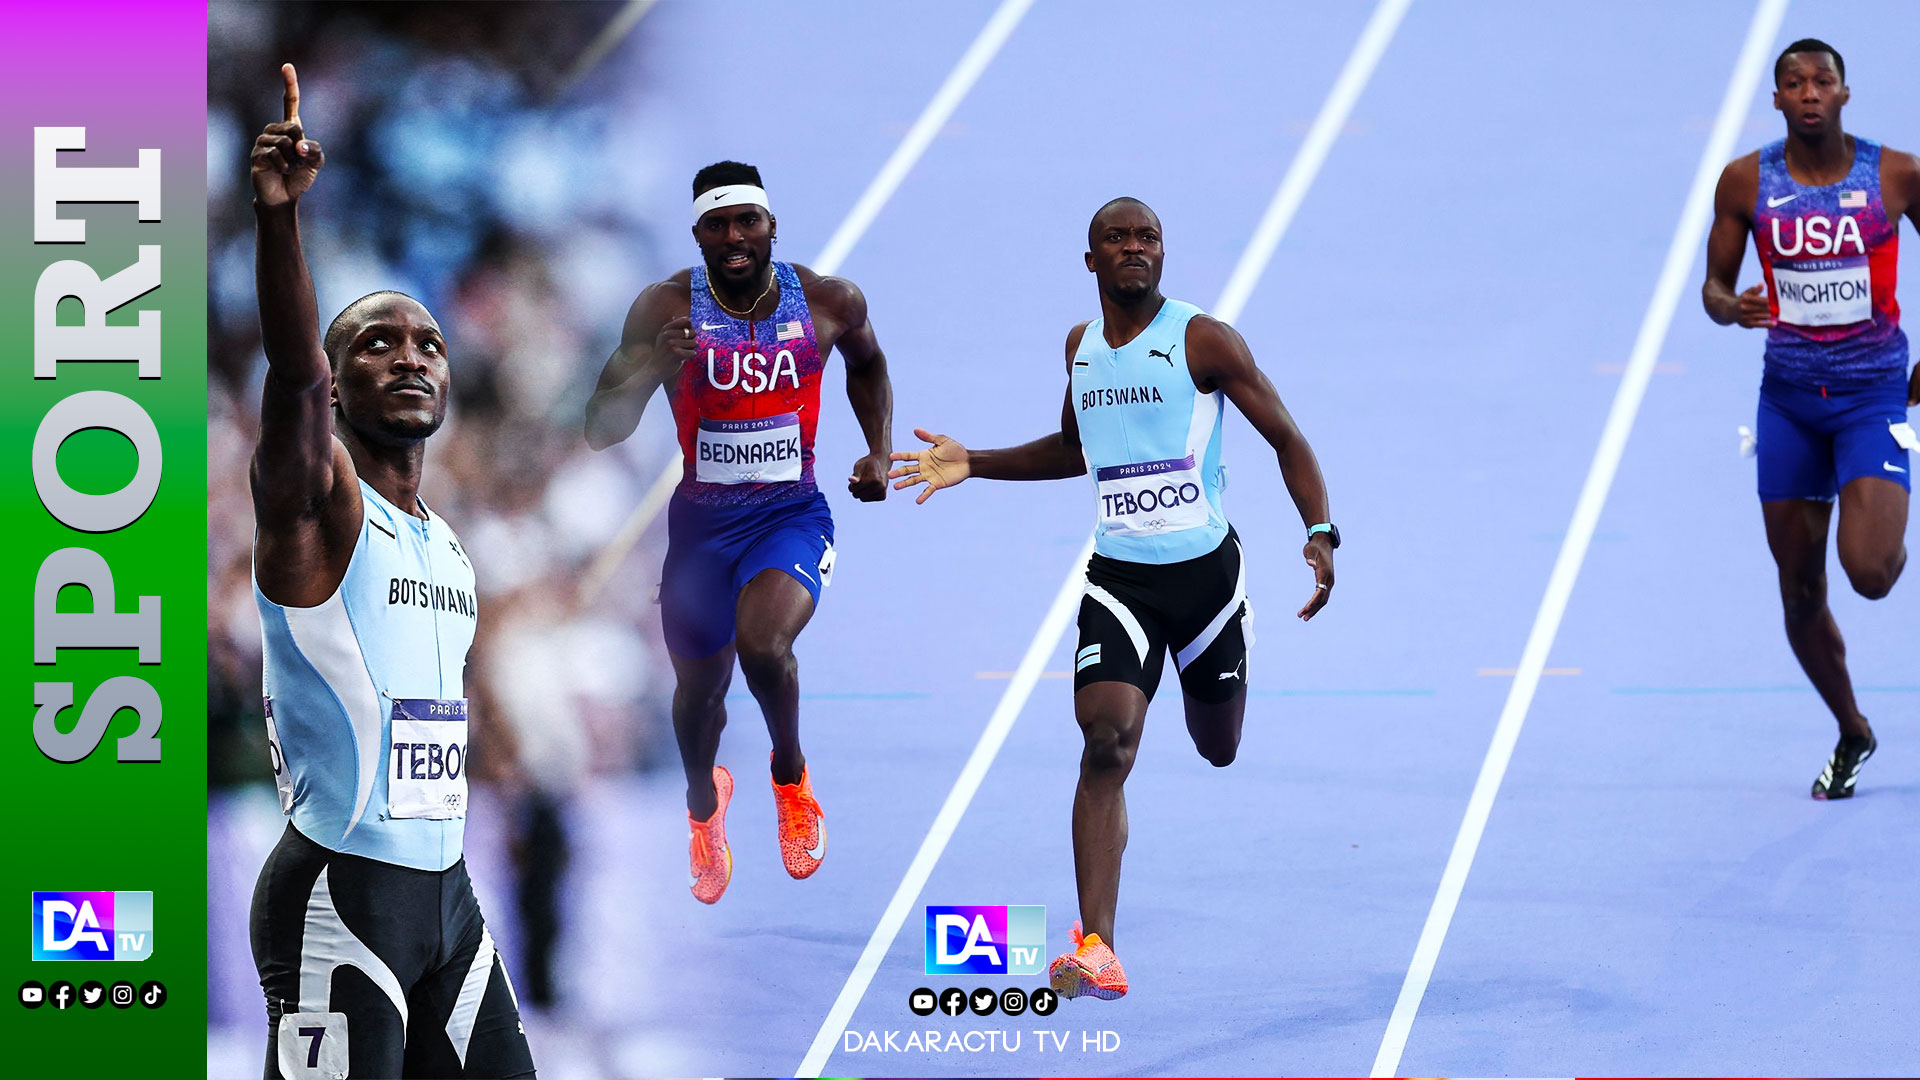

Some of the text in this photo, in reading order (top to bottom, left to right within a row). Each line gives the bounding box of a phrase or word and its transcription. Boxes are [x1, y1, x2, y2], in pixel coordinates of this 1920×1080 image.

[1771, 215, 1865, 256] USA
[1778, 279, 1867, 303] KNIGHTON
[708, 348, 800, 393] USA
[1082, 386, 1163, 411] BOTSWANA
[722, 420, 774, 430] PARIS 2024
[700, 437, 798, 465] BEDNAREK
[1120, 462, 1172, 475] PARIS 2024
[1102, 482, 1200, 517] TEBOGO
[389, 577, 476, 621] BOTSWANA
[430, 704, 460, 715] PARIS
[393, 743, 467, 780] TEBO
[299, 1027, 326, 1068] 7
